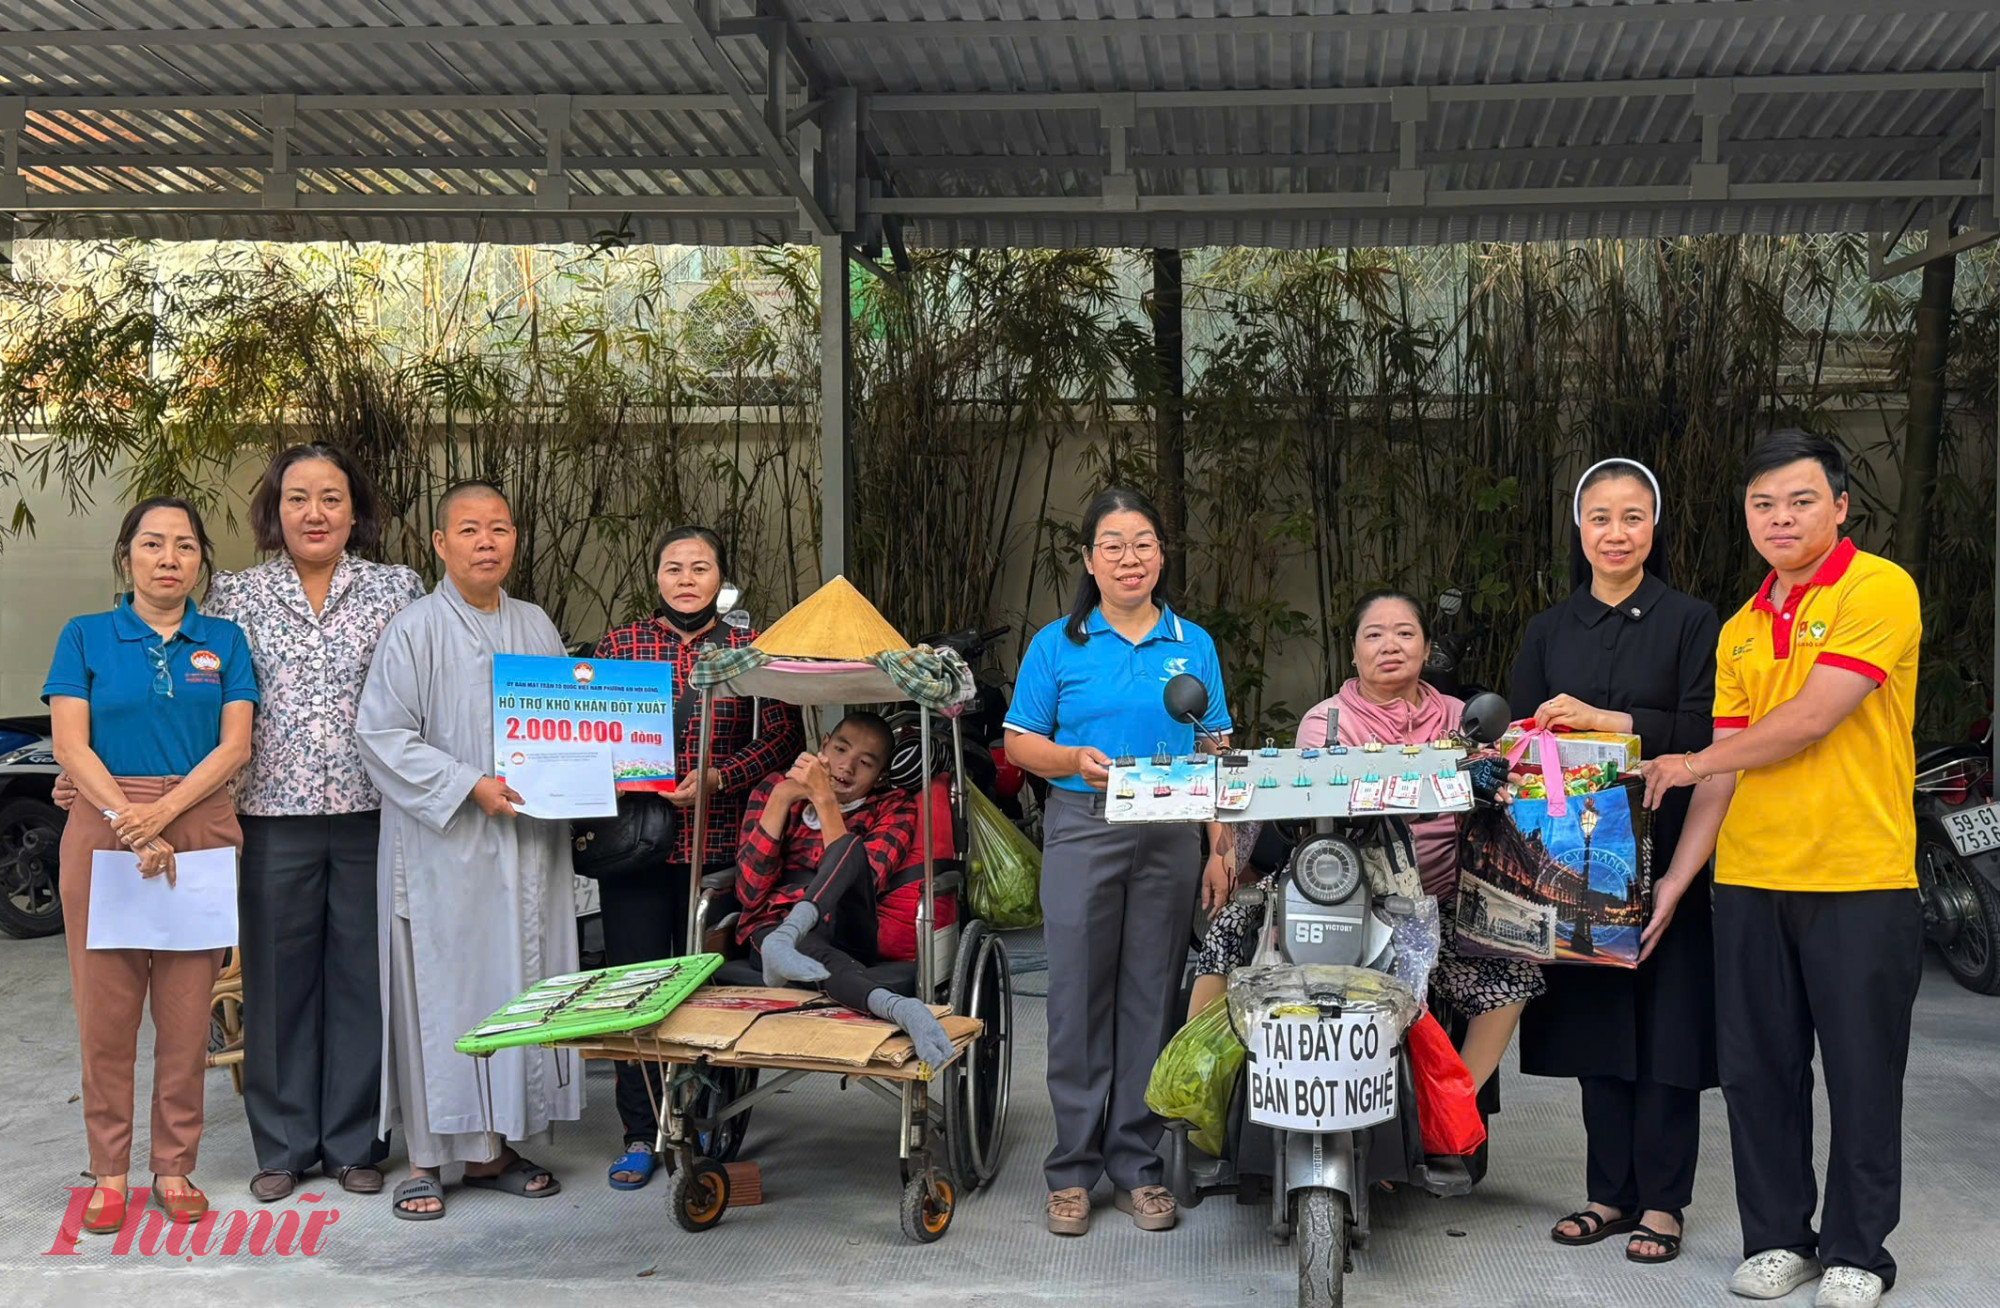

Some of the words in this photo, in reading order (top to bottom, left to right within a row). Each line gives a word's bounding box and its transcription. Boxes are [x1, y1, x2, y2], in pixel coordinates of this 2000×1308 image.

[519, 697, 542, 712] TRỢ
[546, 698, 570, 711] KHÓ
[611, 699, 633, 715] ĐỘT
[637, 699, 666, 714] XUẤT
[506, 717, 622, 743] 2.000.000
[1952, 808, 1998, 832] 59-G1
[1591, 851, 1630, 876] NANCY
[1325, 923, 1352, 933] VICTORY
[1262, 1022, 1292, 1069] TẠI
[1298, 1016, 1343, 1061] ĐÂY
[1350, 1015, 1379, 1061] CÓ
[1252, 1067, 1289, 1115] BÁN
[1295, 1076, 1338, 1127] BỘT
[1345, 1067, 1393, 1115] NGHỆ
